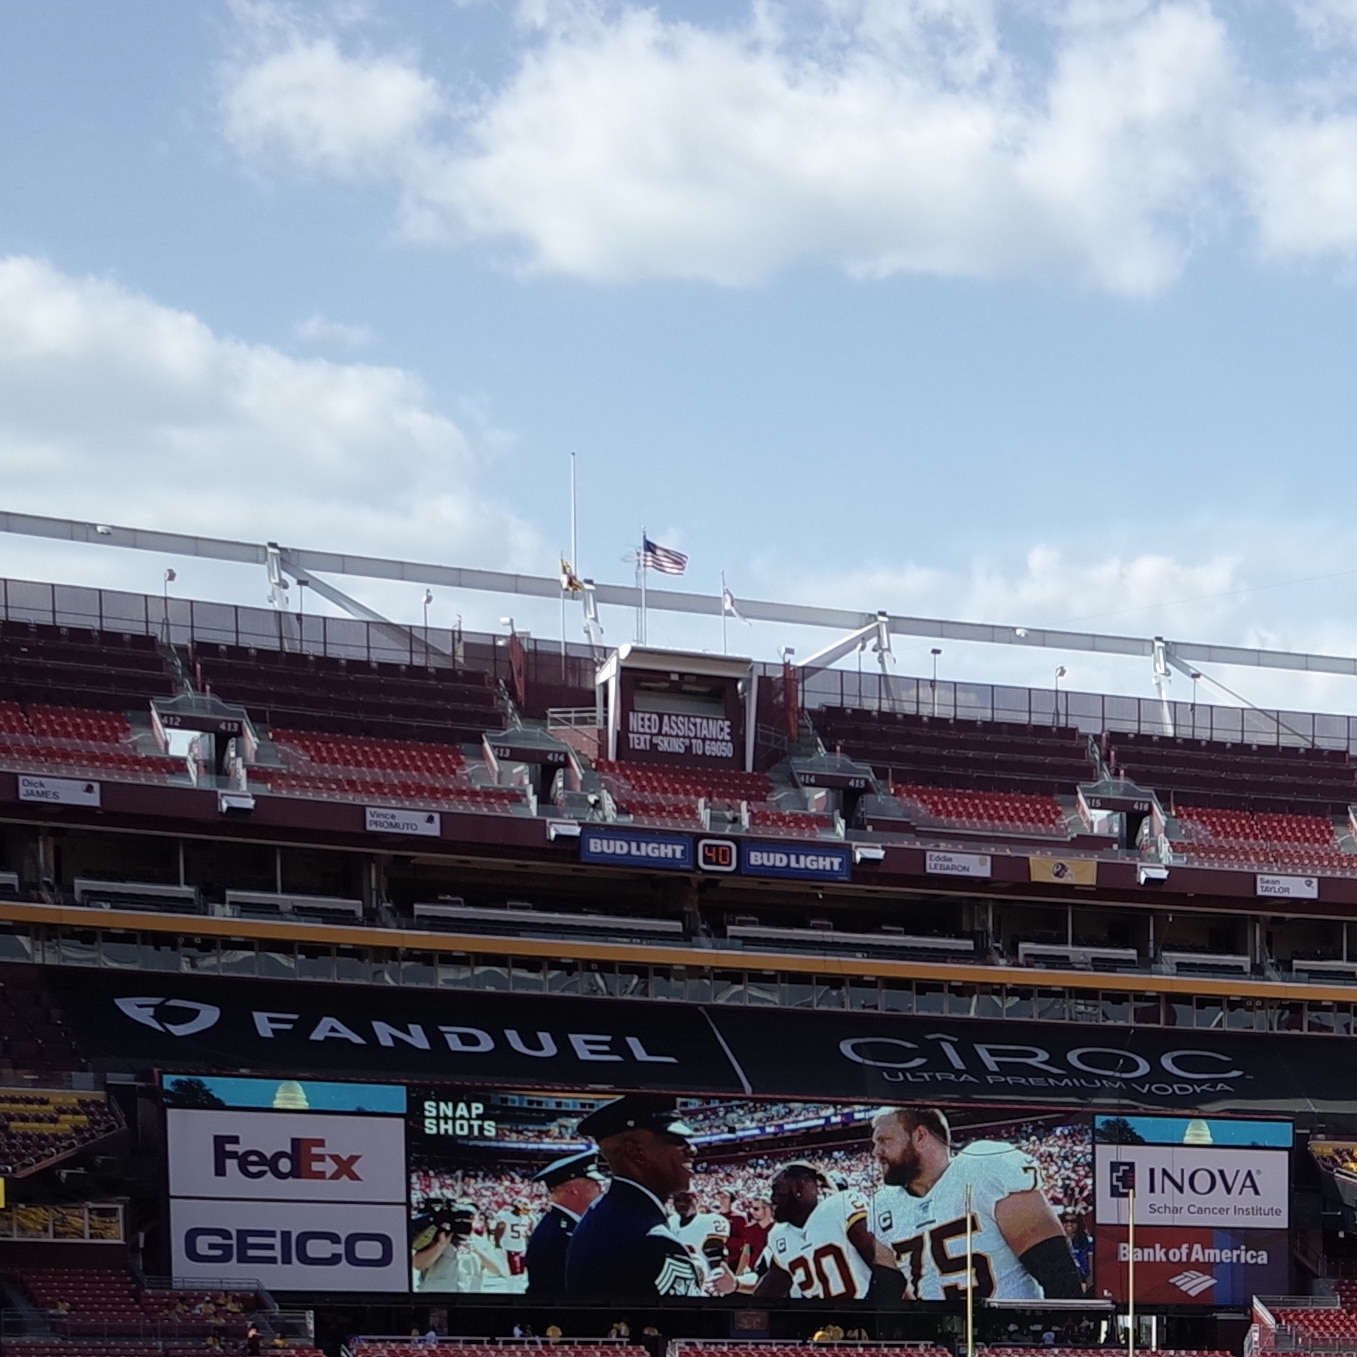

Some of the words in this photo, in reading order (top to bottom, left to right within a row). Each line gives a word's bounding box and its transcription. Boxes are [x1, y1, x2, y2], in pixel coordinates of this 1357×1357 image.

[628, 711, 660, 735] NEED
[662, 715, 731, 741] ASSISTANCE
[628, 733, 651, 750] TEXT
[691, 739, 703, 754] TO
[704, 740, 733, 758] 69050
[22, 778, 46, 789] Dick
[22, 789, 60, 801] JAMES
[370, 810, 396, 821] Vince
[589, 838, 628, 855] BUD
[630, 841, 684, 859] LIGHT
[704, 846, 731, 865] 40
[929, 853, 953, 863] Eddie
[750, 851, 788, 867] BUD
[789, 852, 843, 872] LIGHT
[929, 862, 970, 873] LEBARON
[1259, 877, 1280, 886] Sean
[1259, 885, 1290, 895] TAYLOR
[251, 1009, 679, 1064] FANDUEL
[882, 1071, 979, 1085] ULTRA
[985, 1074, 1126, 1090] PREMIUM
[1130, 1081, 1235, 1096] VODKA
[424, 1101, 484, 1120] SNAP
[424, 1118, 497, 1137] SHOTS
[212, 1134, 364, 1182] FedEx
[1148, 1167, 1262, 1197] INOVA
[1148, 1203, 1184, 1215] Schar
[1187, 1204, 1230, 1216] Cancer
[1233, 1204, 1283, 1217] Institute
[183, 1226, 394, 1268] GEICO
[891, 1212, 997, 1300] 75
[1118, 1242, 1167, 1263] Bank
[1167, 1243, 1189, 1263] of
[1190, 1243, 1269, 1265] America
[788, 1242, 860, 1300] 20
